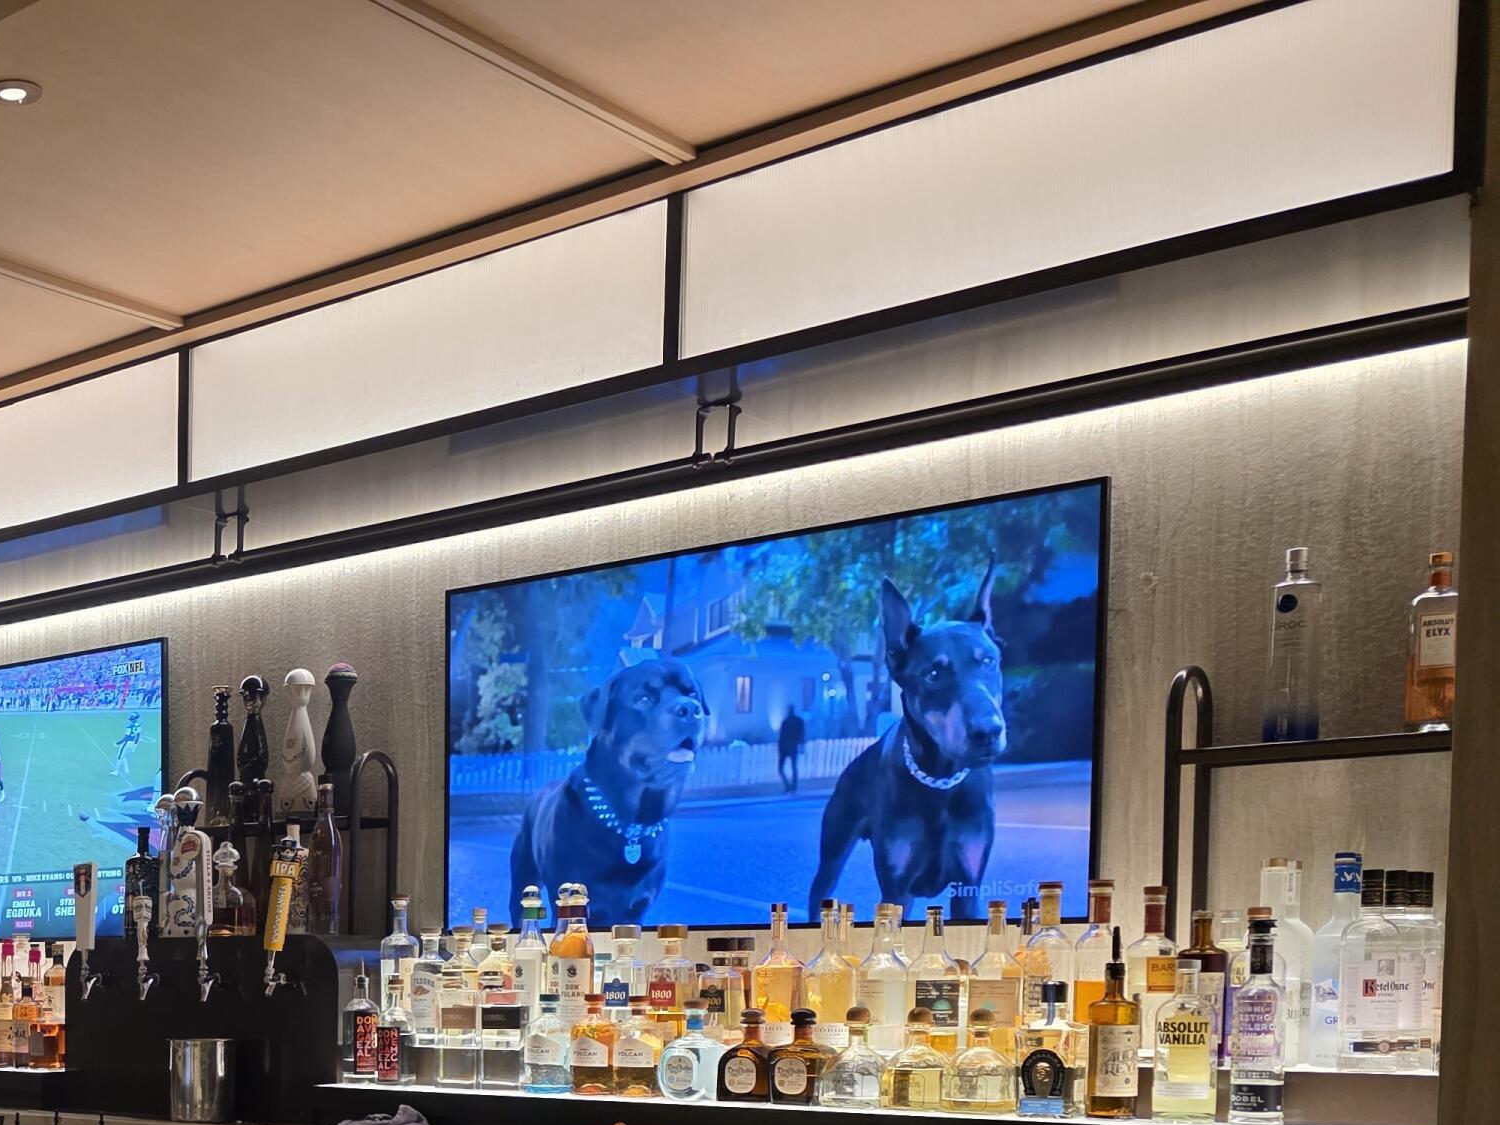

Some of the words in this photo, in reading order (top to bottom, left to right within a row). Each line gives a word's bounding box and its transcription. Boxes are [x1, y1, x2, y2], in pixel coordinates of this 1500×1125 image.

[1422, 618, 1454, 627] ABSOLUT
[1426, 627, 1450, 637] ELYX
[113, 663, 128, 675] FOX
[129, 662, 143, 673] NFL
[275, 863, 296, 876] IPA
[6, 907, 41, 918] EGBUKA
[606, 990, 626, 1000] 1800
[651, 989, 672, 999] 1800
[1157, 1021, 1209, 1033] ABSOLUT
[1158, 1033, 1206, 1045] VANILIA
